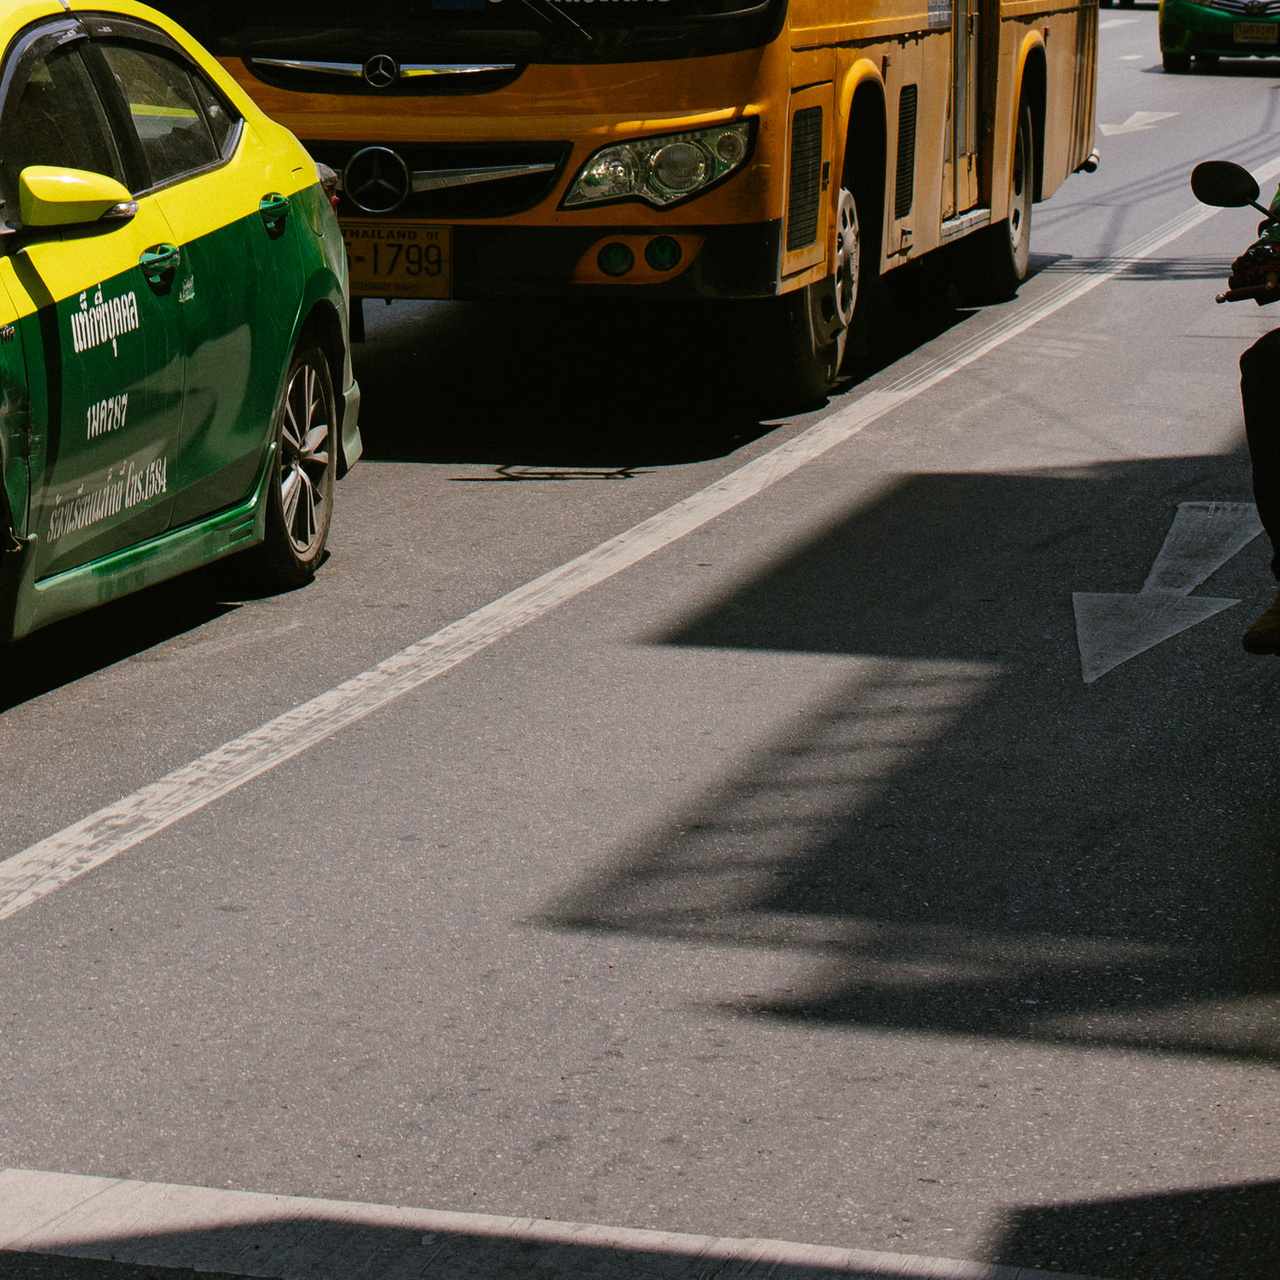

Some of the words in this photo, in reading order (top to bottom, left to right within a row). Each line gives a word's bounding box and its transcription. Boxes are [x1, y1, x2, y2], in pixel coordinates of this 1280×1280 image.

[342, 230, 417, 239] THAILAND
[70, 283, 139, 358] แท็กซี่บุคคล
